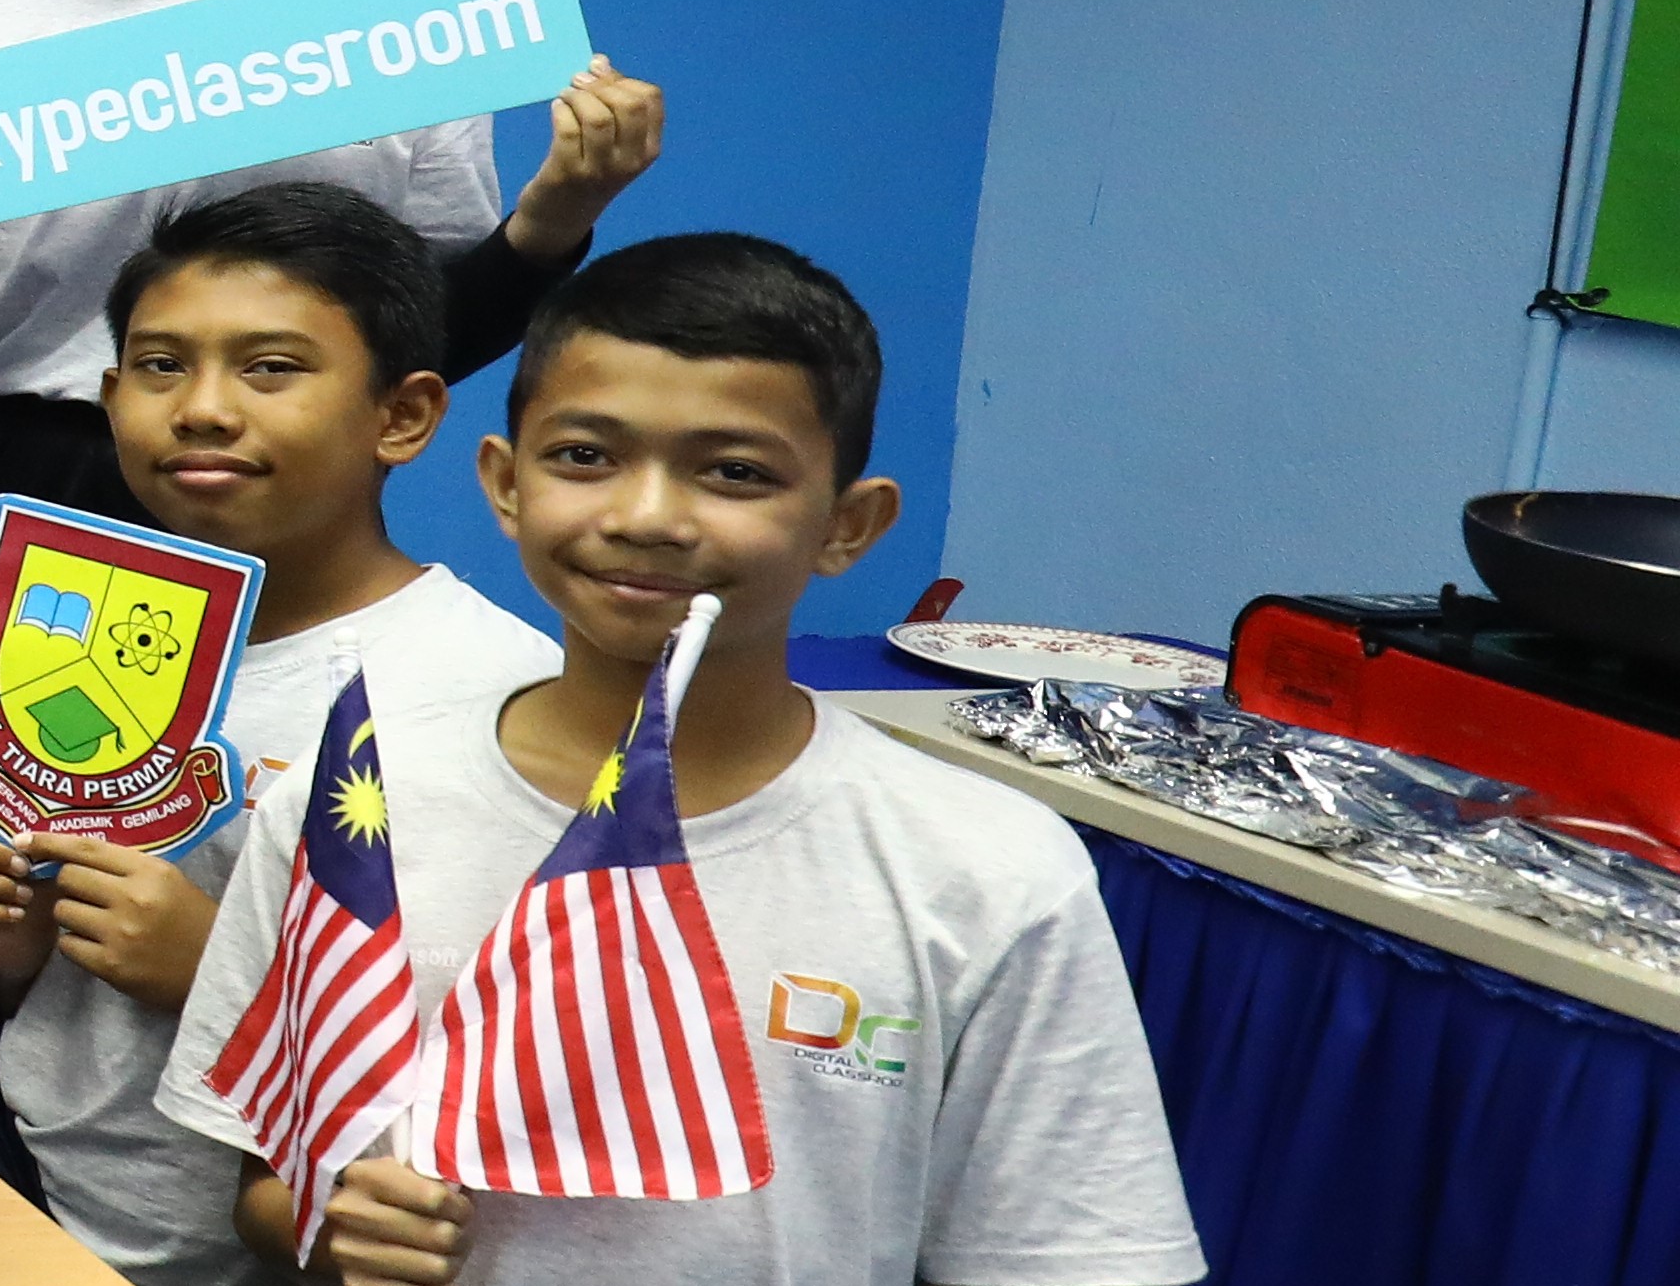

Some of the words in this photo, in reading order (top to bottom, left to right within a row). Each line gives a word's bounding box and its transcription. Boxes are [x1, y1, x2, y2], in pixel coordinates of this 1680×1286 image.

[1, 741, 74, 797] TIARA
[83, 743, 177, 800] PERMAI
[48, 816, 113, 833] AKADEMIK
[121, 794, 193, 829] GEMILANG
[794, 1047, 854, 1067] DIGITAL
